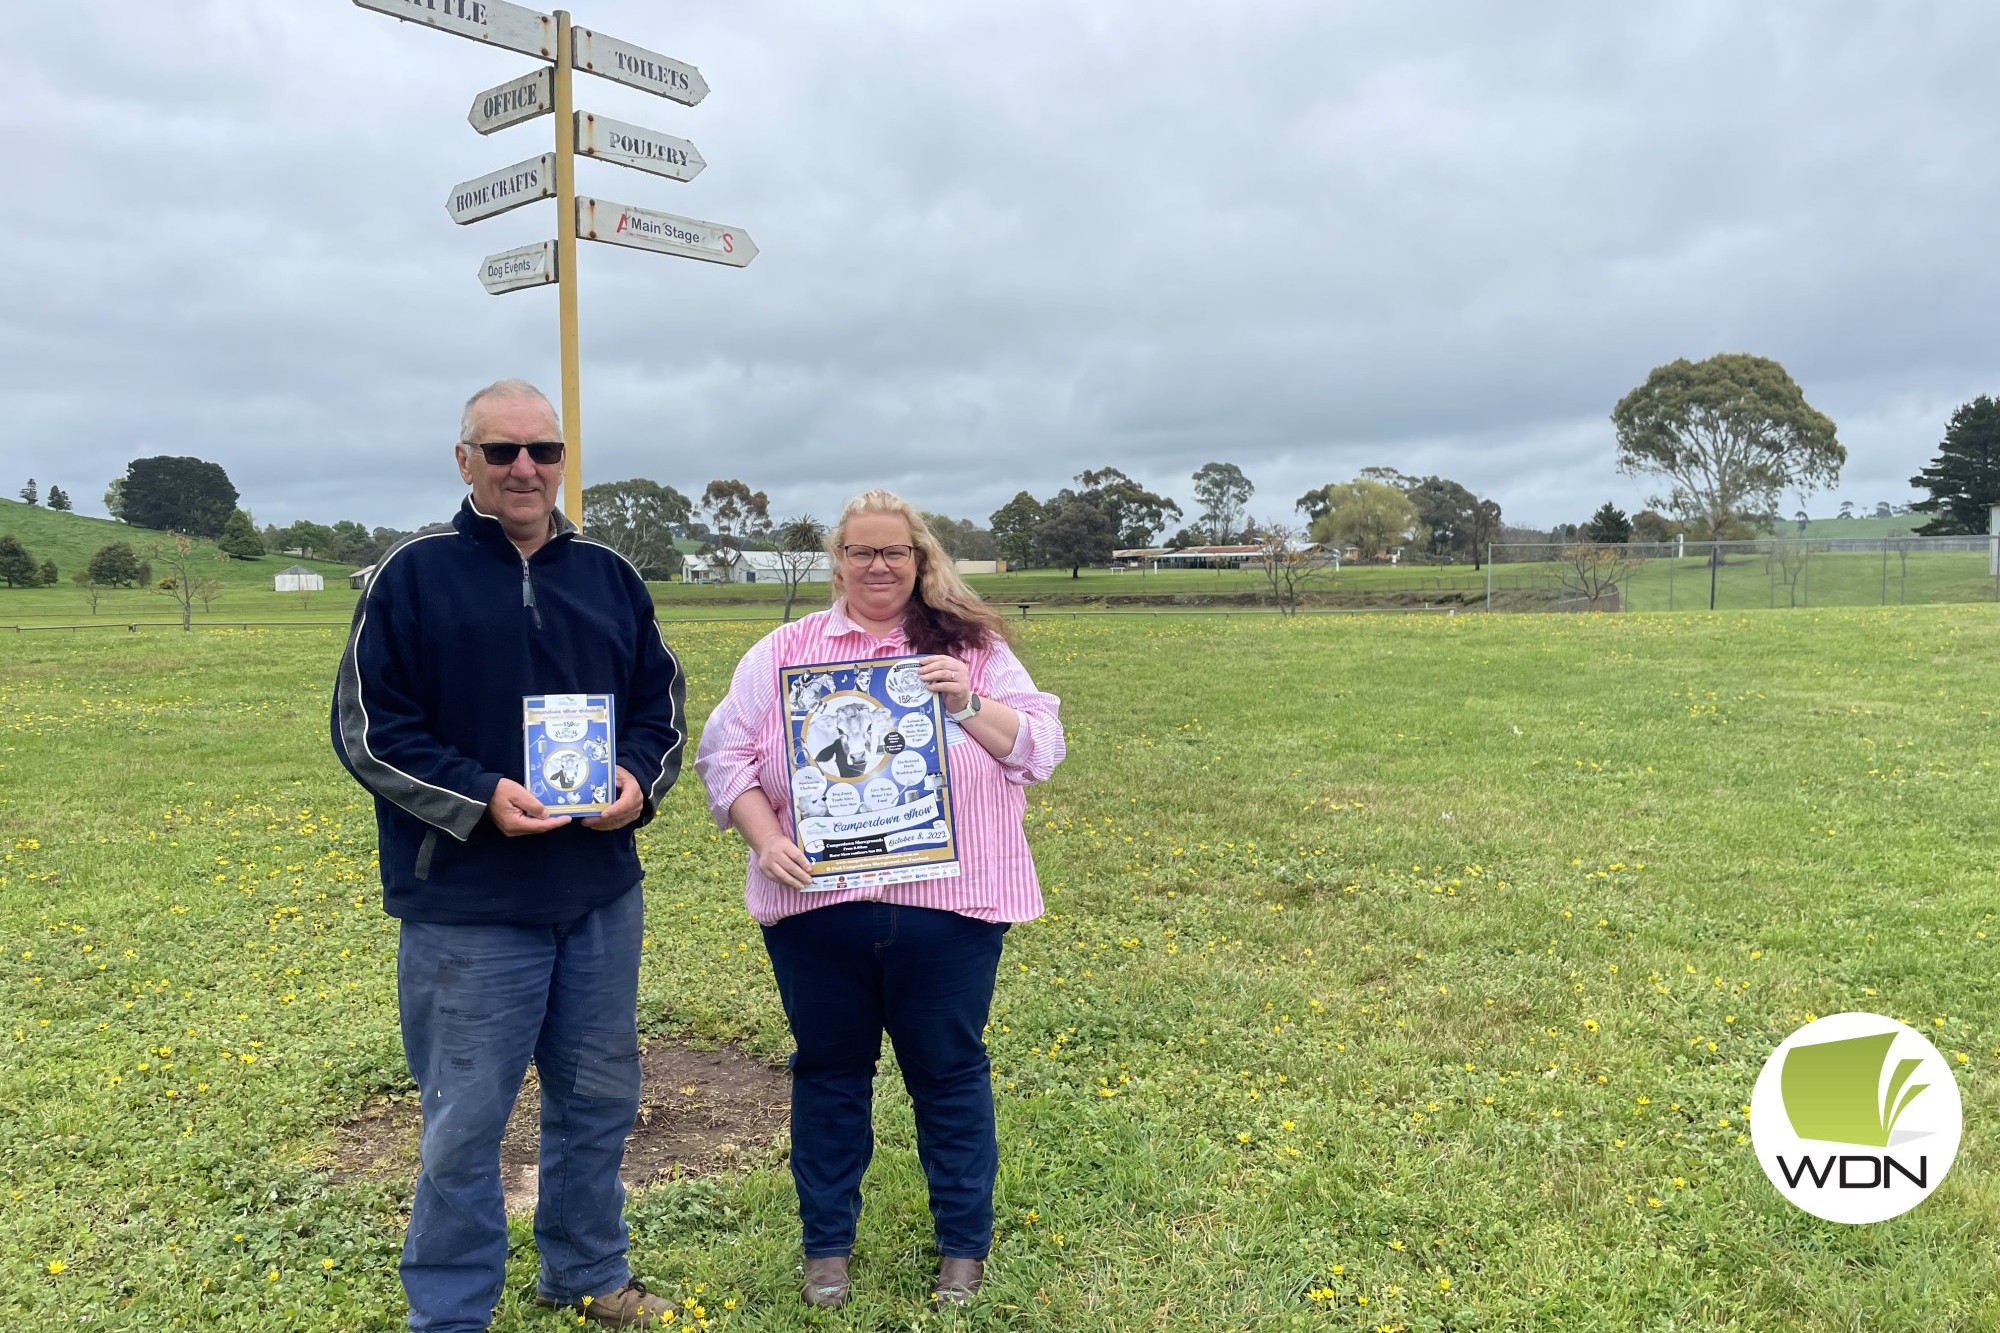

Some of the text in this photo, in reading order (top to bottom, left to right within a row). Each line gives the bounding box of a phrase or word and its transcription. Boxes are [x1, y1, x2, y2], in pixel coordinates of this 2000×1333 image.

[615, 51, 689, 90] TOILETS
[483, 83, 537, 119] OFFICE
[609, 131, 689, 167] POULTRY
[456, 169, 538, 212] HOME CRAFTS
[631, 216, 700, 244] Main Stage
[488, 260, 531, 278] Dog Events
[833, 805, 932, 832] Camperdown Show
[888, 835, 915, 847] October
